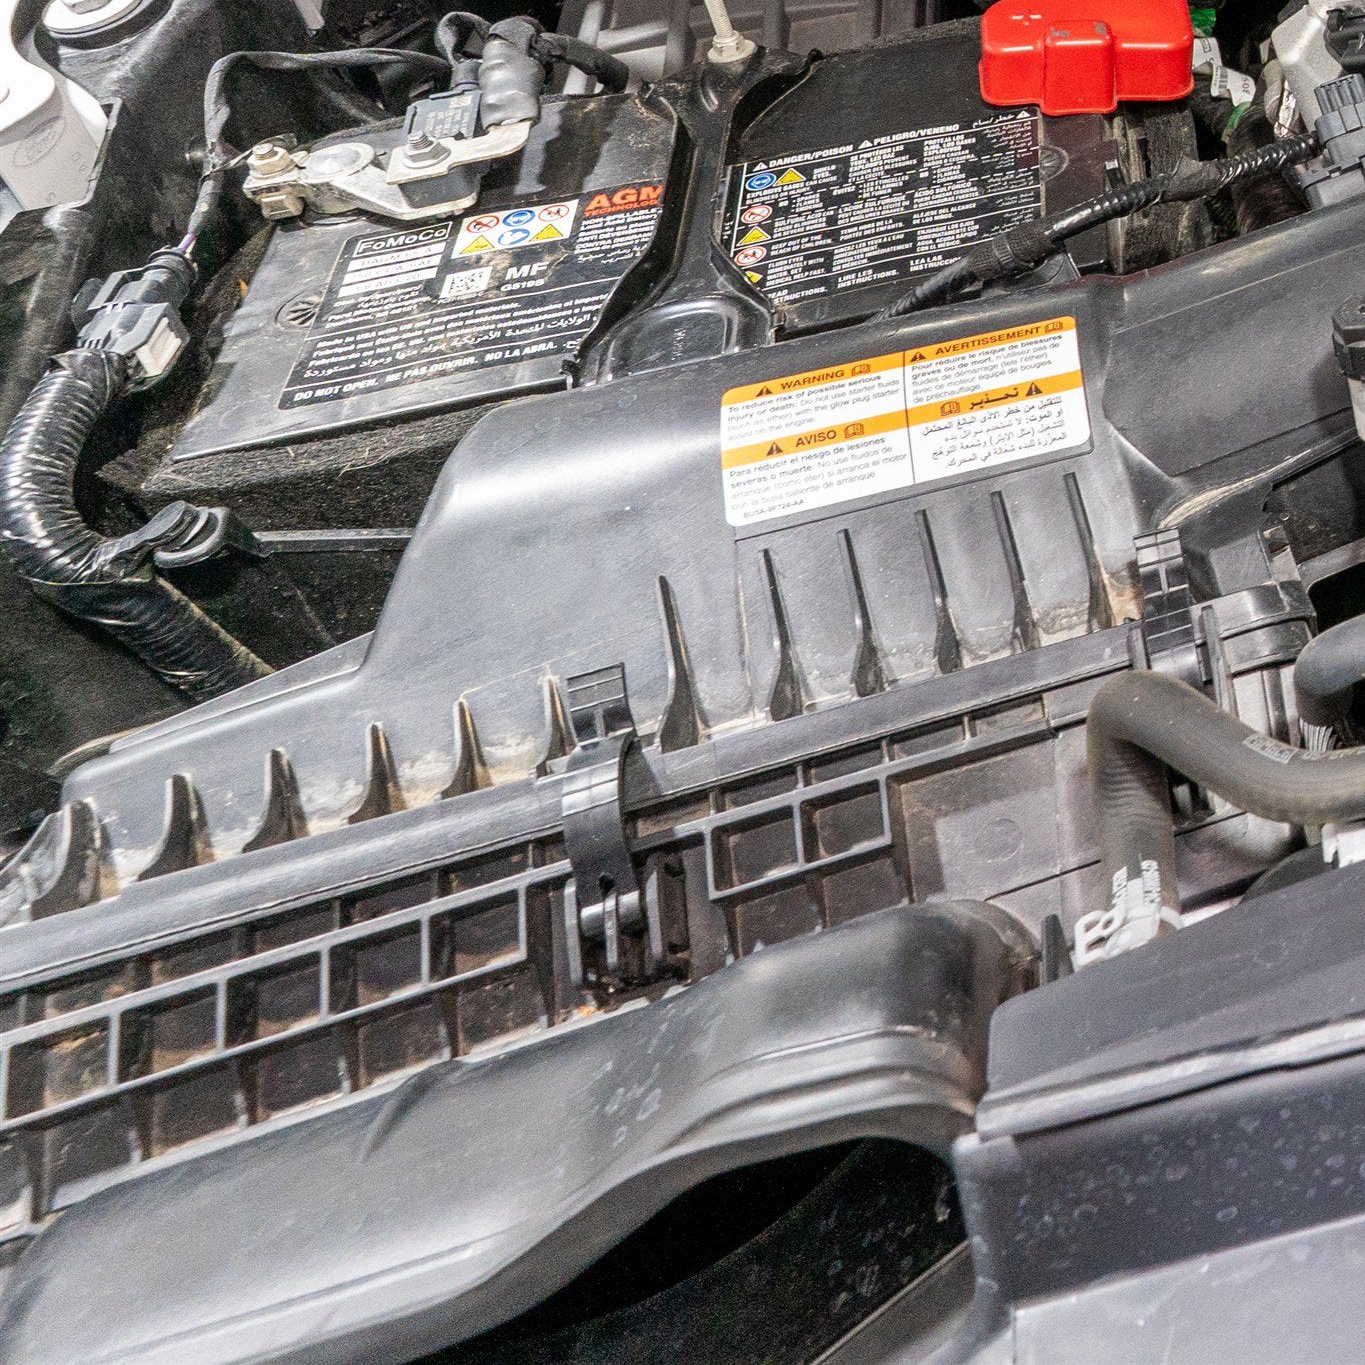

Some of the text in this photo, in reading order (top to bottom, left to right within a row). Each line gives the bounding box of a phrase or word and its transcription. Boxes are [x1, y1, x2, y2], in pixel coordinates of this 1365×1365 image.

[873, 123, 959, 145] PELIGRO/VENENO
[769, 144, 853, 167] DANGER/POISON
[582, 198, 659, 217] TECHNOLOG
[585, 182, 665, 210] AGM
[358, 227, 447, 252] FoMoCo
[503, 260, 550, 280] MF
[909, 257, 925, 266] LEA
[837, 268, 899, 288] INSTRUCTIONS.
[838, 268, 873, 282] LIRE LES
[772, 285, 828, 304] STRUCTIONS.
[355, 330, 377, 340] USA
[934, 325, 1041, 356] AVERTISSEMENT
[911, 362, 933, 372] Pour
[934, 353, 965, 366] réduire
[978, 345, 1005, 358] risque
[1007, 342, 1018, 350] de
[1020, 332, 1063, 347] blessures
[911, 367, 941, 380] graves
[944, 364, 955, 372] ou
[957, 361, 968, 369] de
[995, 346, 1030, 360] n'utilisez
[1032, 344, 1047, 353] pas
[1048, 340, 1060, 349] de
[292, 390, 314, 401] DO
[313, 384, 342, 397] NOT
[341, 376, 381, 392] OPEN.
[384, 371, 403, 382] NE
[402, 365, 430, 378] PAS
[483, 350, 503, 362] NO
[502, 347, 522, 358] LA
[521, 340, 559, 355] ABRA.
[780, 368, 845, 390] WARNING
[912, 375, 939, 387] fluides
[940, 372, 952, 380] de
[953, 361, 998, 379] démarrage
[912, 385, 933, 395] avec
[946, 375, 976, 387] moteur
[977, 368, 1006, 381] équipé
[1007, 365, 1018, 374] de
[1020, 357, 1052, 372] bougies
[728, 374, 881, 413] To reduce risk of possible serious
[800, 398, 812, 406] Do
[815, 394, 828, 402] not
[830, 391, 846, 399] use
[848, 384, 875, 395] starter
[877, 378, 900, 389] fluids
[814, 403, 828, 412] the
[829, 398, 849, 409] glow
[851, 394, 870, 405] plug
[872, 387, 899, 399] starter
[913, 395, 924, 404] de
[794, 428, 837, 447] AVISO
[729, 436, 885, 478] Para reducir el riesgo de lesiones
[730, 474, 767, 489] severas
[817, 459, 830, 468] No
[833, 455, 849, 464] use
[850, 447, 879, 461] fluidos
[881, 445, 892, 453] de
[871, 458, 880, 466] el
[882, 452, 907, 464] motor
